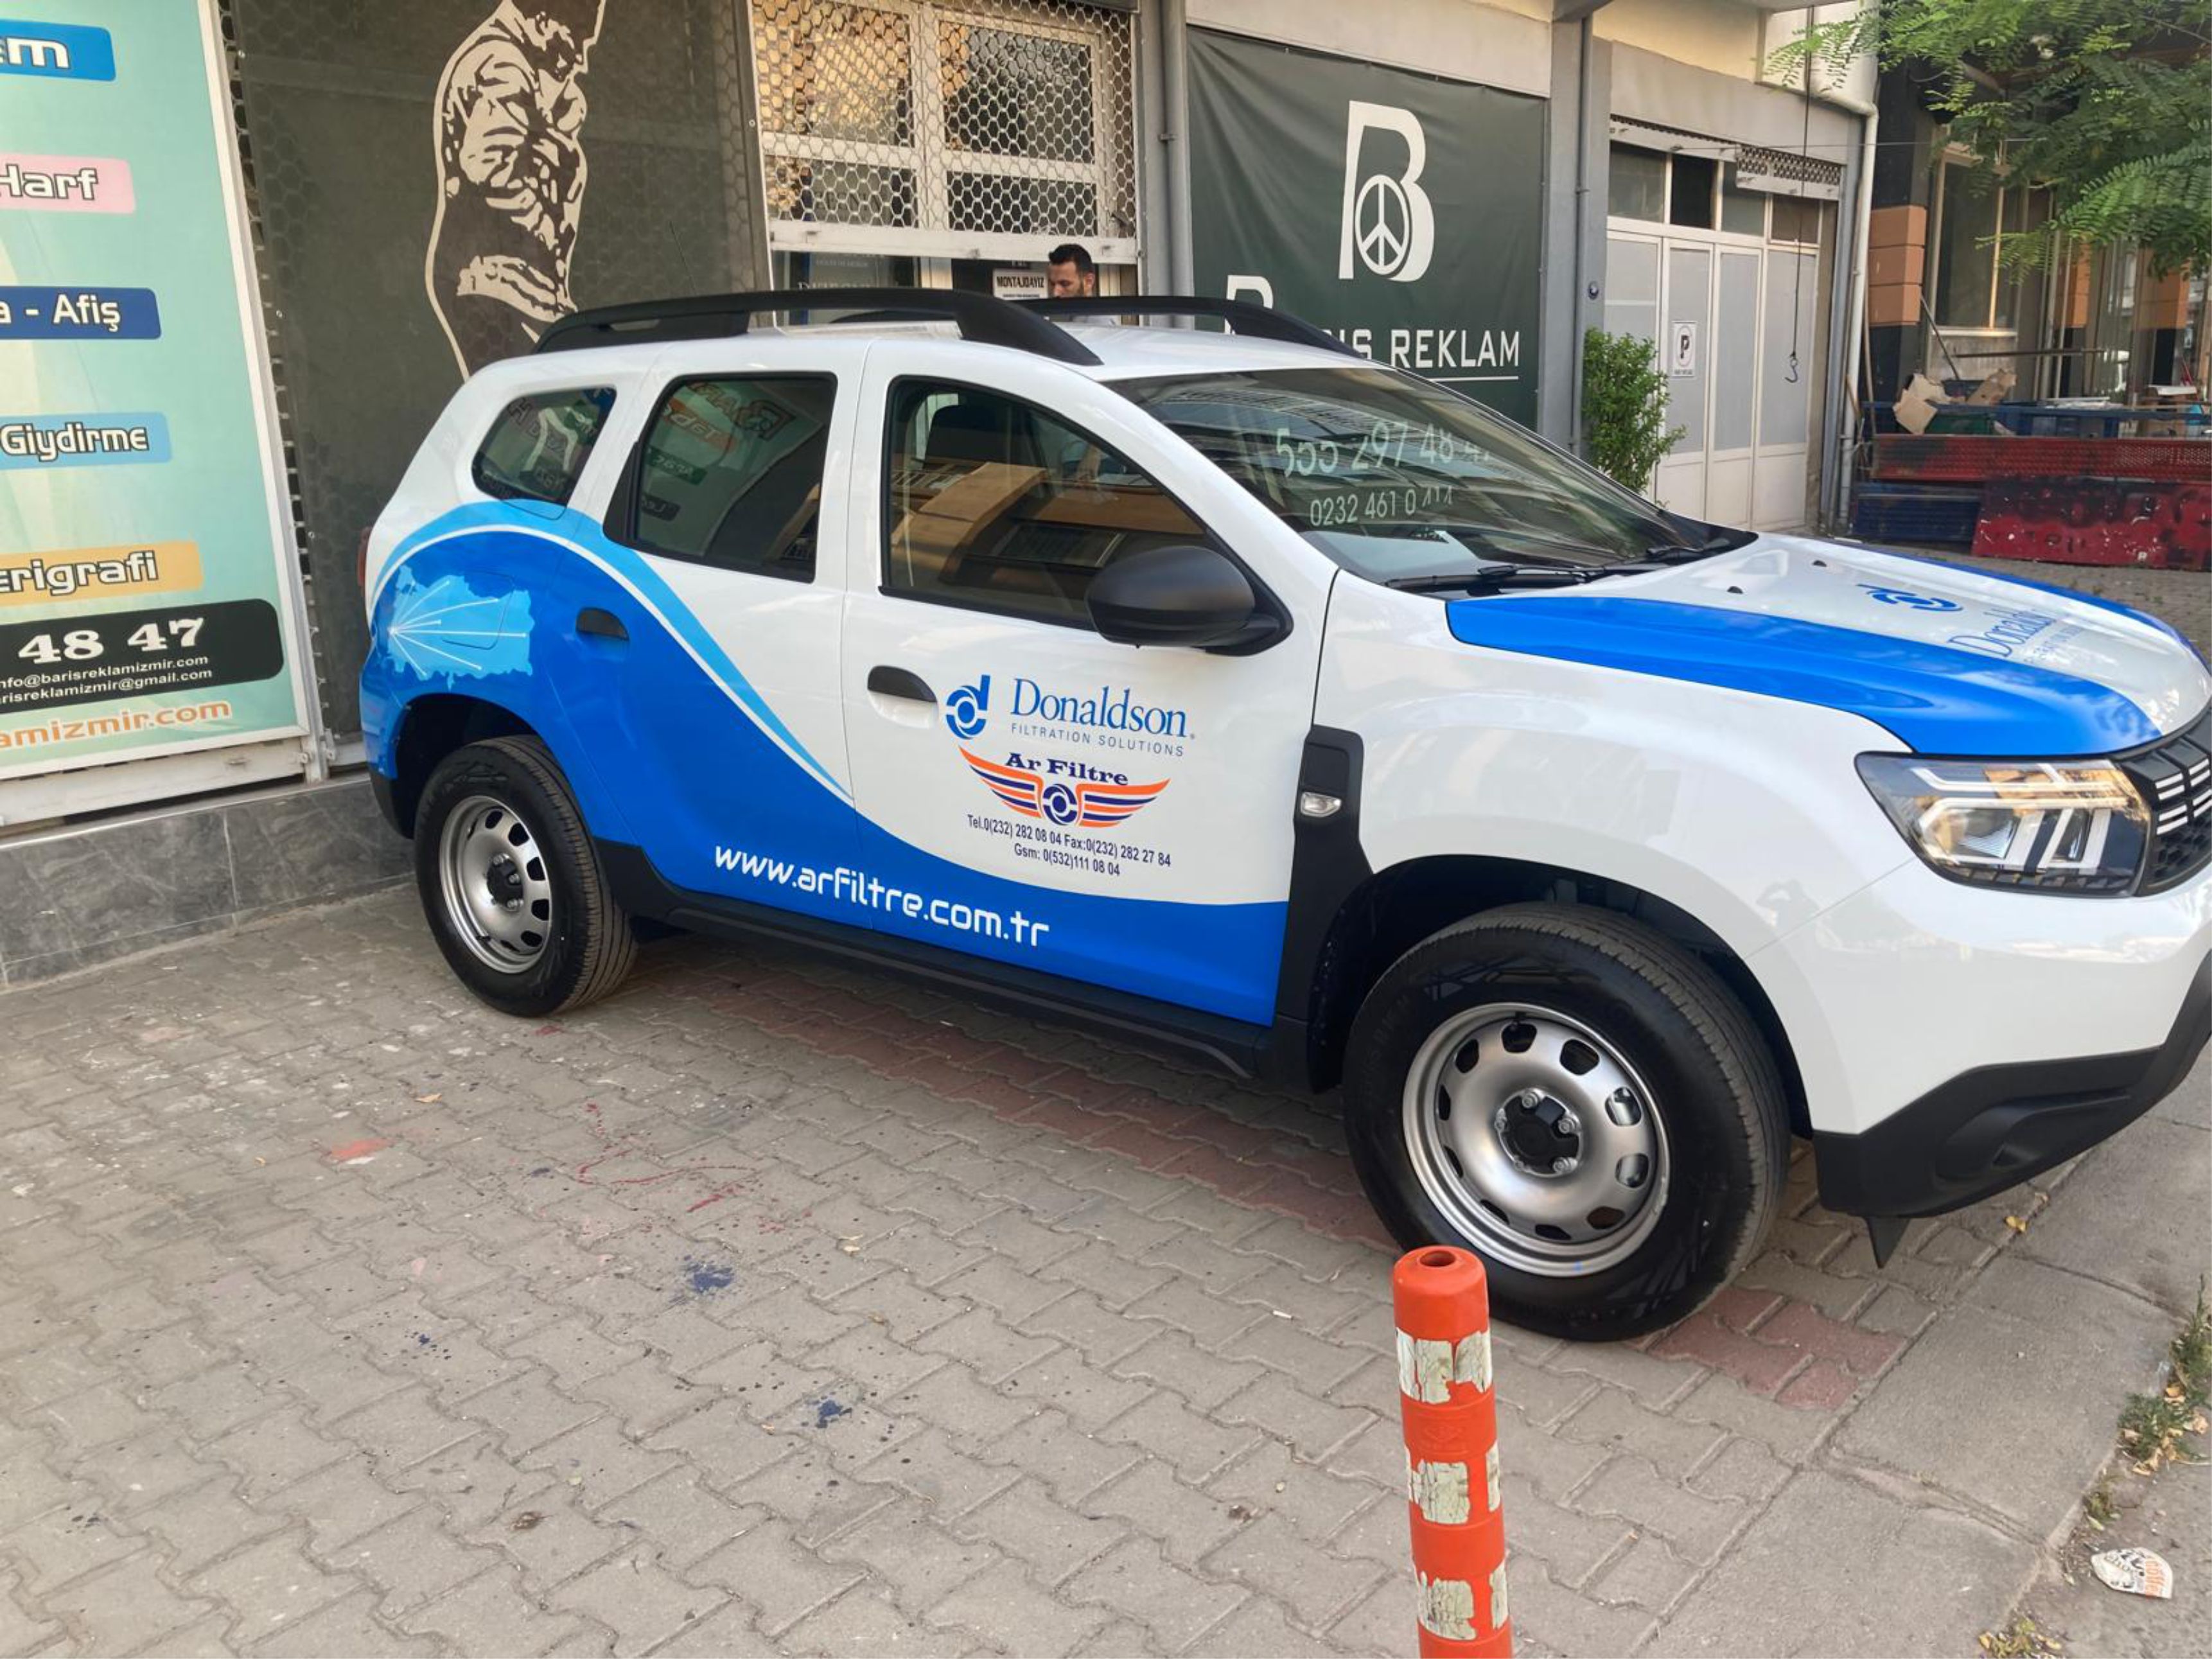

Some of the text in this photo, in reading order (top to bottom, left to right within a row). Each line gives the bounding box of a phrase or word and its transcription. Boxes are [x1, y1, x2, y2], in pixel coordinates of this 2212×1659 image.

[0, 36, 70, 69] m
[53, 294, 121, 333] Afiş
[1390, 329, 1520, 369] REKLAM
[0, 421, 150, 462] Giydirme
[1310, 494, 1358, 527] 0232
[1365, 490, 1396, 520] 461
[18, 617, 205, 665] 48 47
[0, 669, 213, 705] risreklamizmir@gmail.com
[1010, 678, 1187, 738] Donaldson
[1012, 722, 1184, 757] FILTRATION SOLUTIONS
[1005, 752, 1129, 786] Ar Filtre
[1014, 843, 1040, 859] Gsm:
[1093, 861, 1105, 874] 08
[1108, 864, 1121, 877] 04
[1015, 823, 1031, 839] 282
[1035, 828, 1047, 843] 08
[1049, 831, 1062, 846] 04
[1121, 845, 1139, 860] 282
[1142, 849, 1155, 864] 27
[1158, 852, 1172, 867] 84
[715, 845, 1050, 947] www.arfiltre.com.tr
